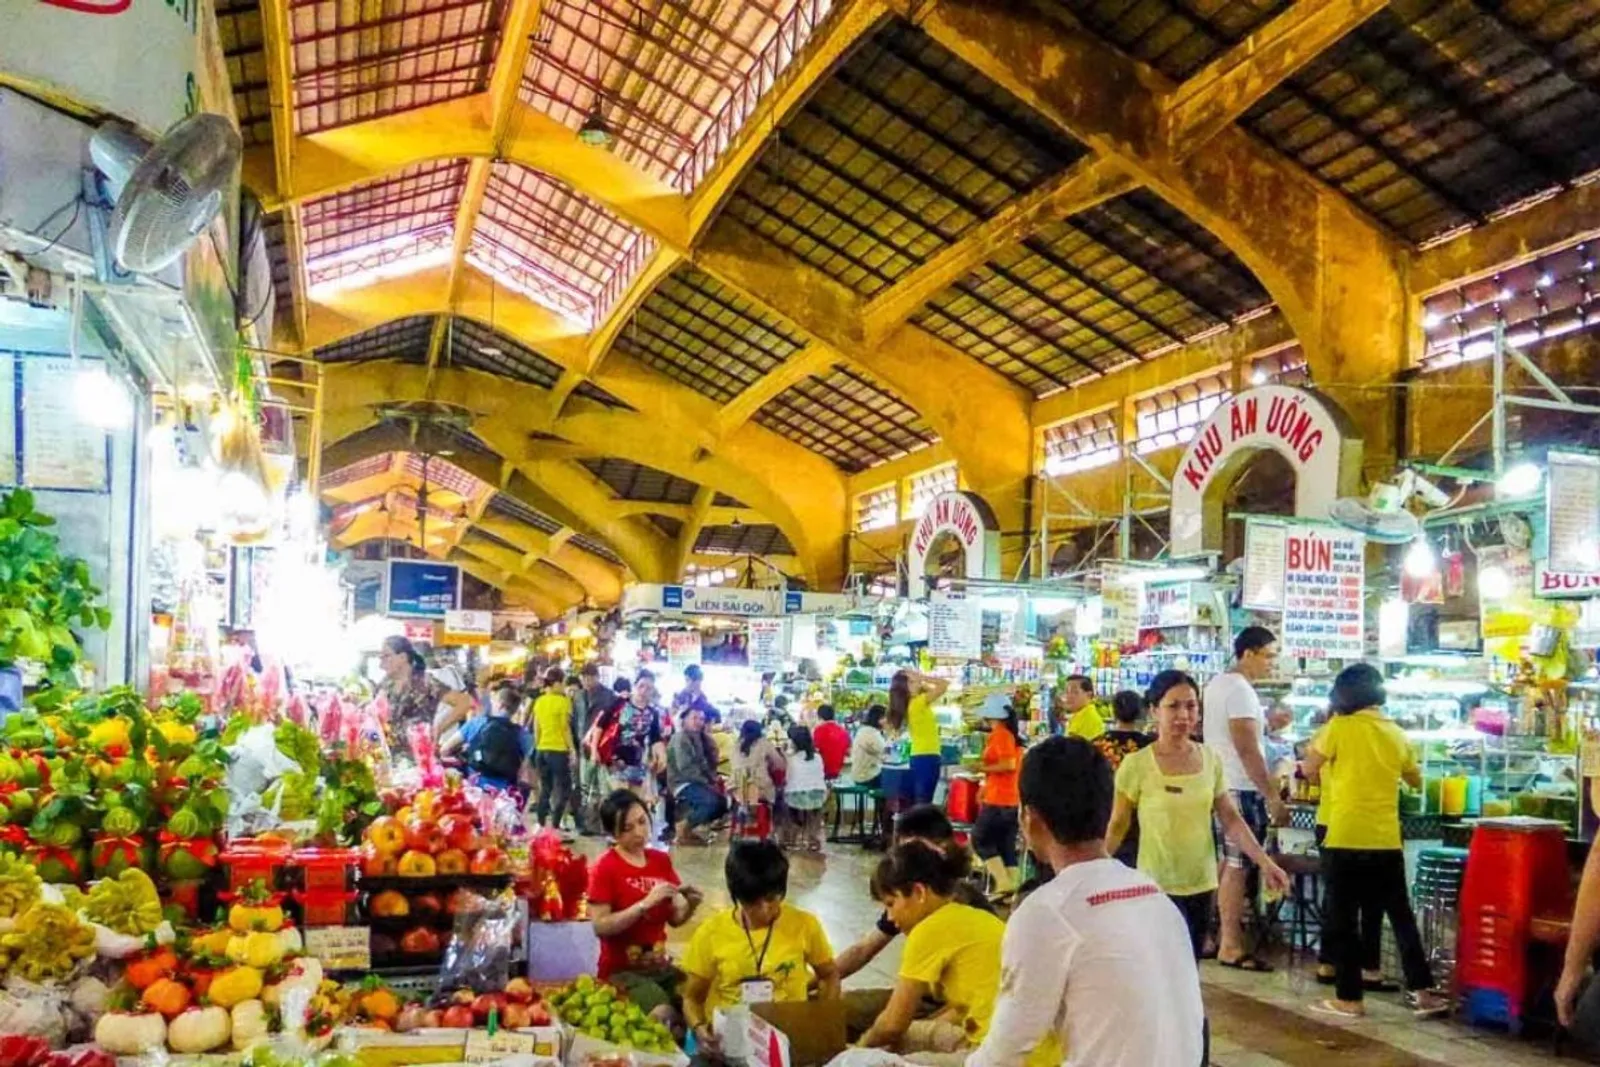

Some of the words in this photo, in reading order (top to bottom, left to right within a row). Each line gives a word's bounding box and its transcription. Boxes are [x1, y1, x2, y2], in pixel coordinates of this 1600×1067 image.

[1183, 423, 1223, 490] KHU
[1230, 397, 1258, 442] ĂN
[1266, 395, 1323, 462] UỐNG
[915, 514, 933, 557] KHU
[1288, 531, 1332, 571] BÚN
